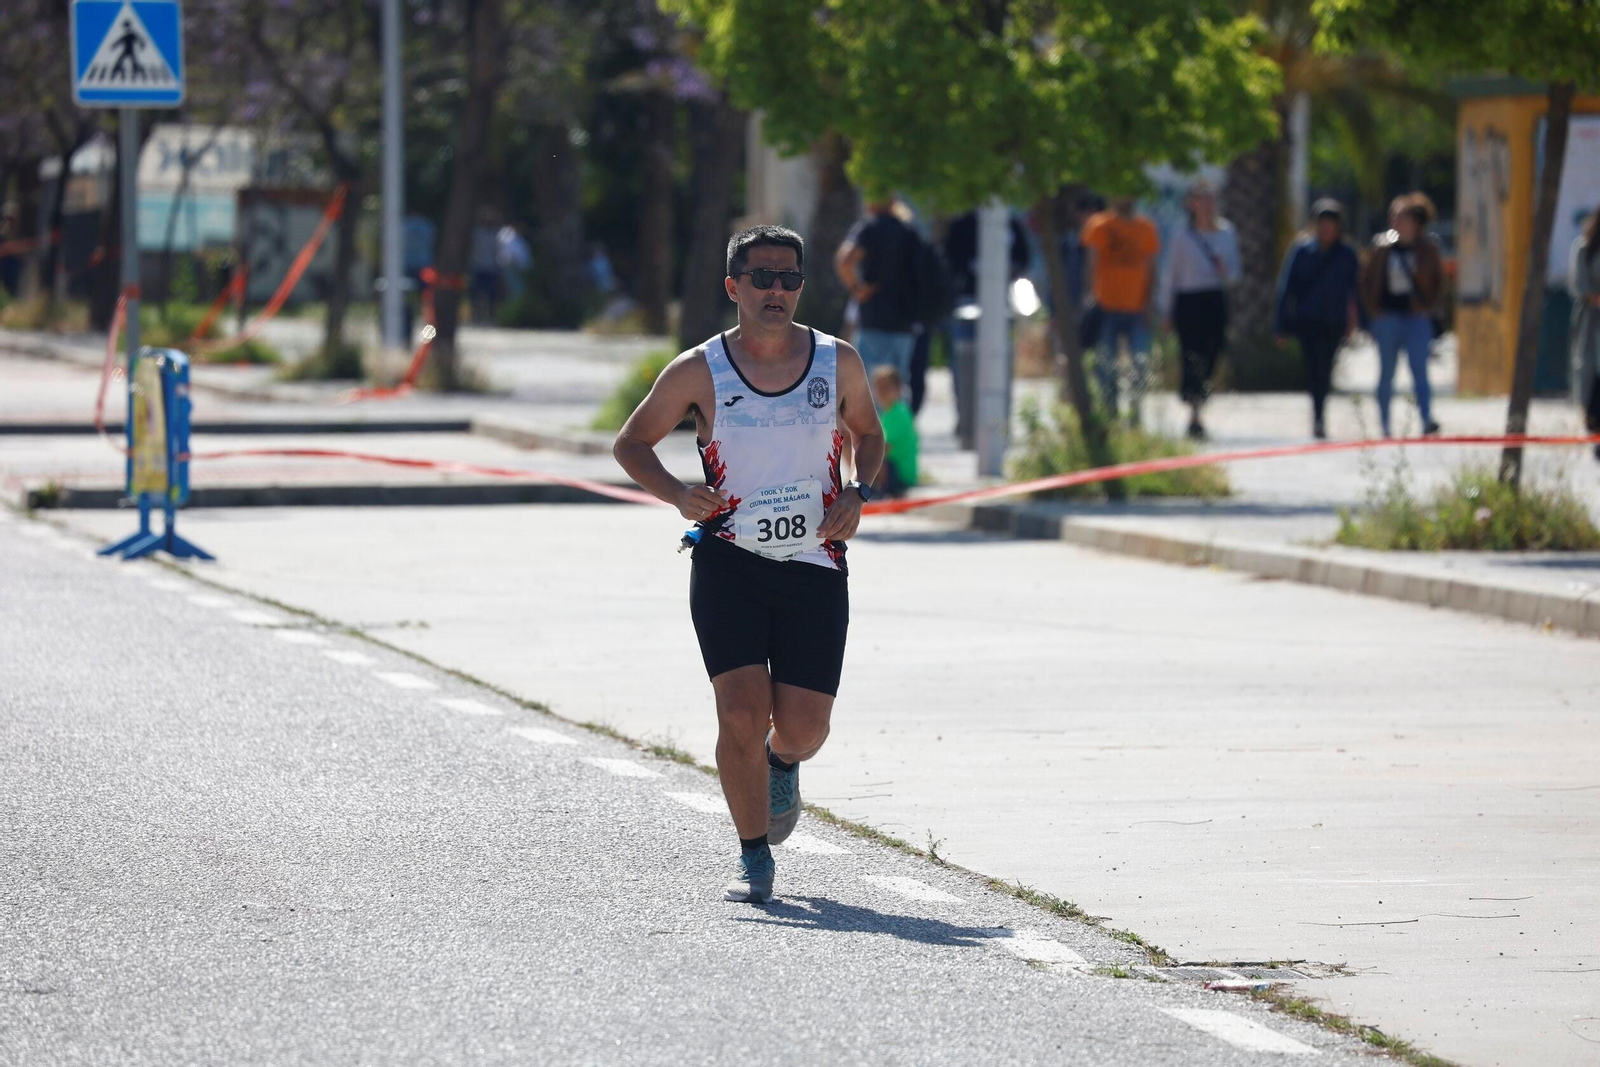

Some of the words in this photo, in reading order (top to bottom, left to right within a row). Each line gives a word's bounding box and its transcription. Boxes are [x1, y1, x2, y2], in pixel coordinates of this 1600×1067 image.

[749, 500, 772, 508] CIUDAD
[783, 493, 810, 502] MÁLAGA
[773, 505, 790, 513] 2025
[757, 514, 807, 543] 308
